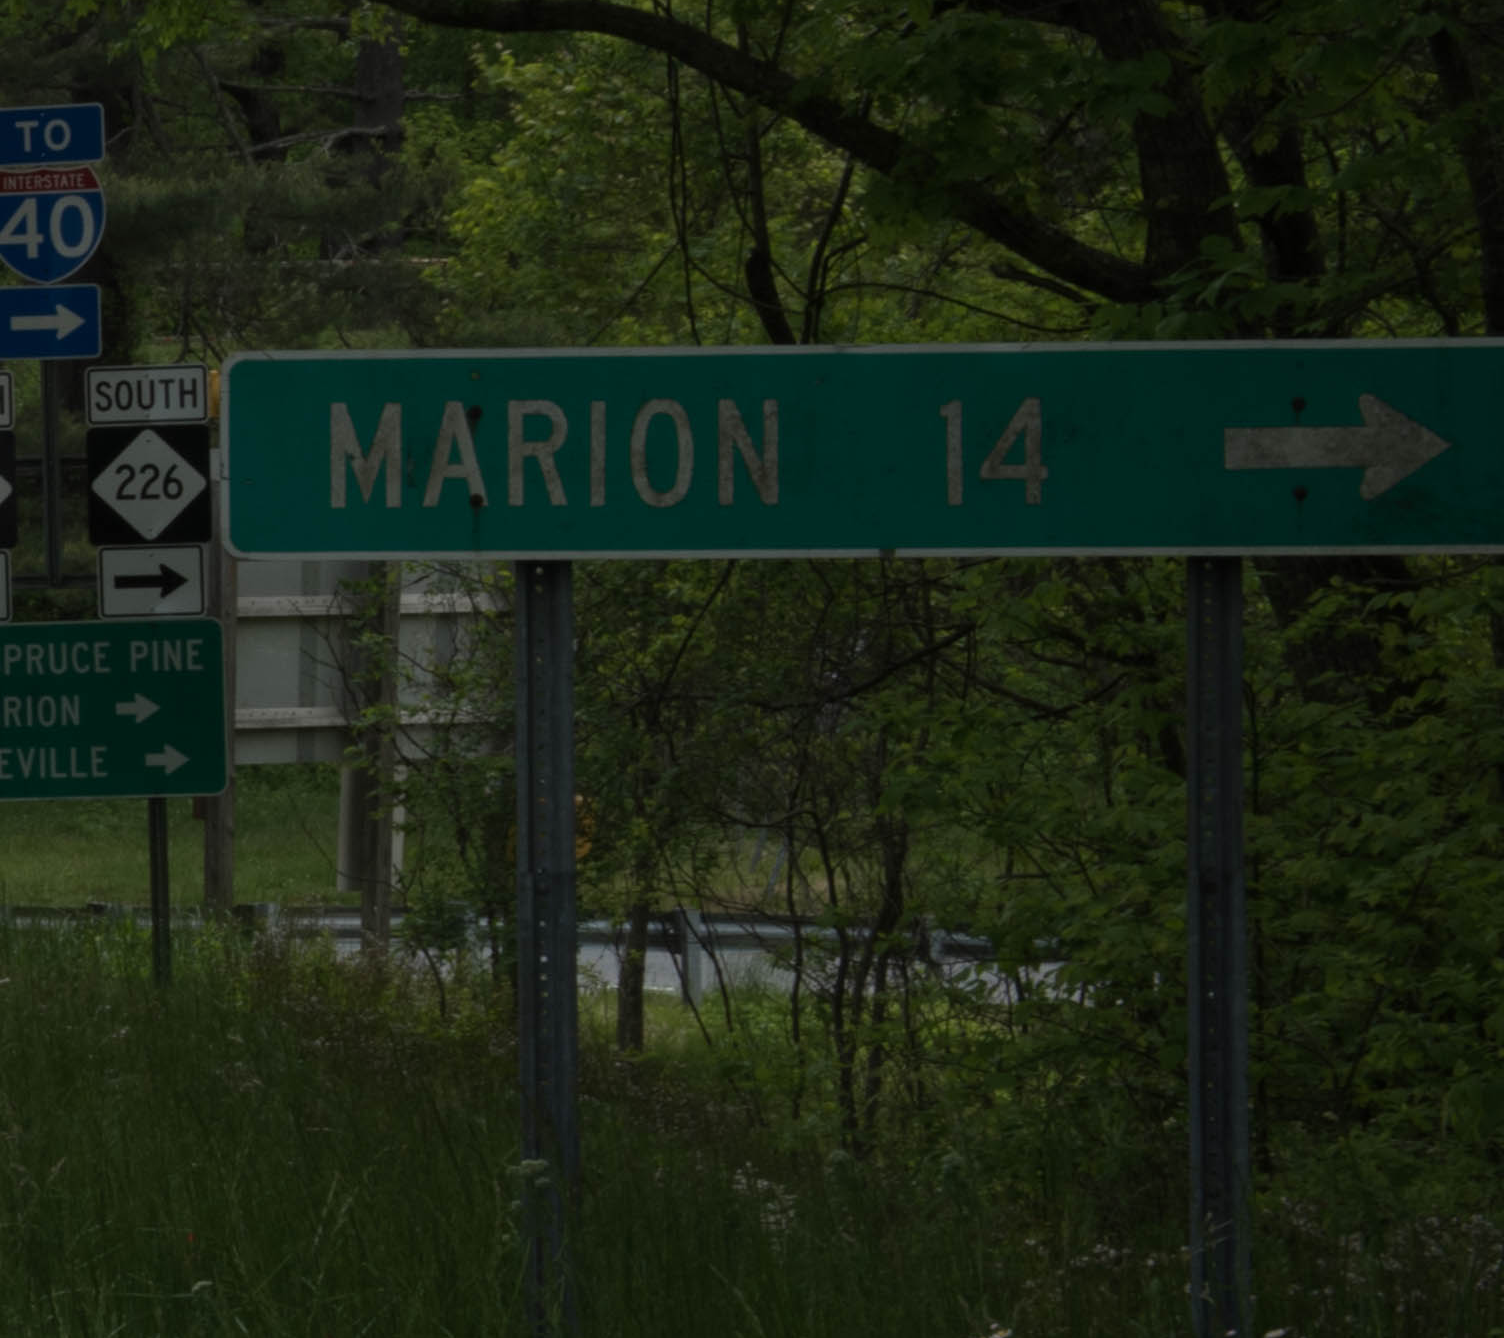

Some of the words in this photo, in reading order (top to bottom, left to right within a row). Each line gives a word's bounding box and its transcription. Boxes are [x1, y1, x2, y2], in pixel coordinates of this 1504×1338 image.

[14, 118, 72, 153] TO
[2, 172, 86, 191] INTERSTATE
[95, 377, 198, 411] SOUTH
[329, 397, 782, 510] MARION
[939, 396, 1048, 507] 14
[115, 463, 183, 500] 226
[128, 637, 206, 673] PINE
